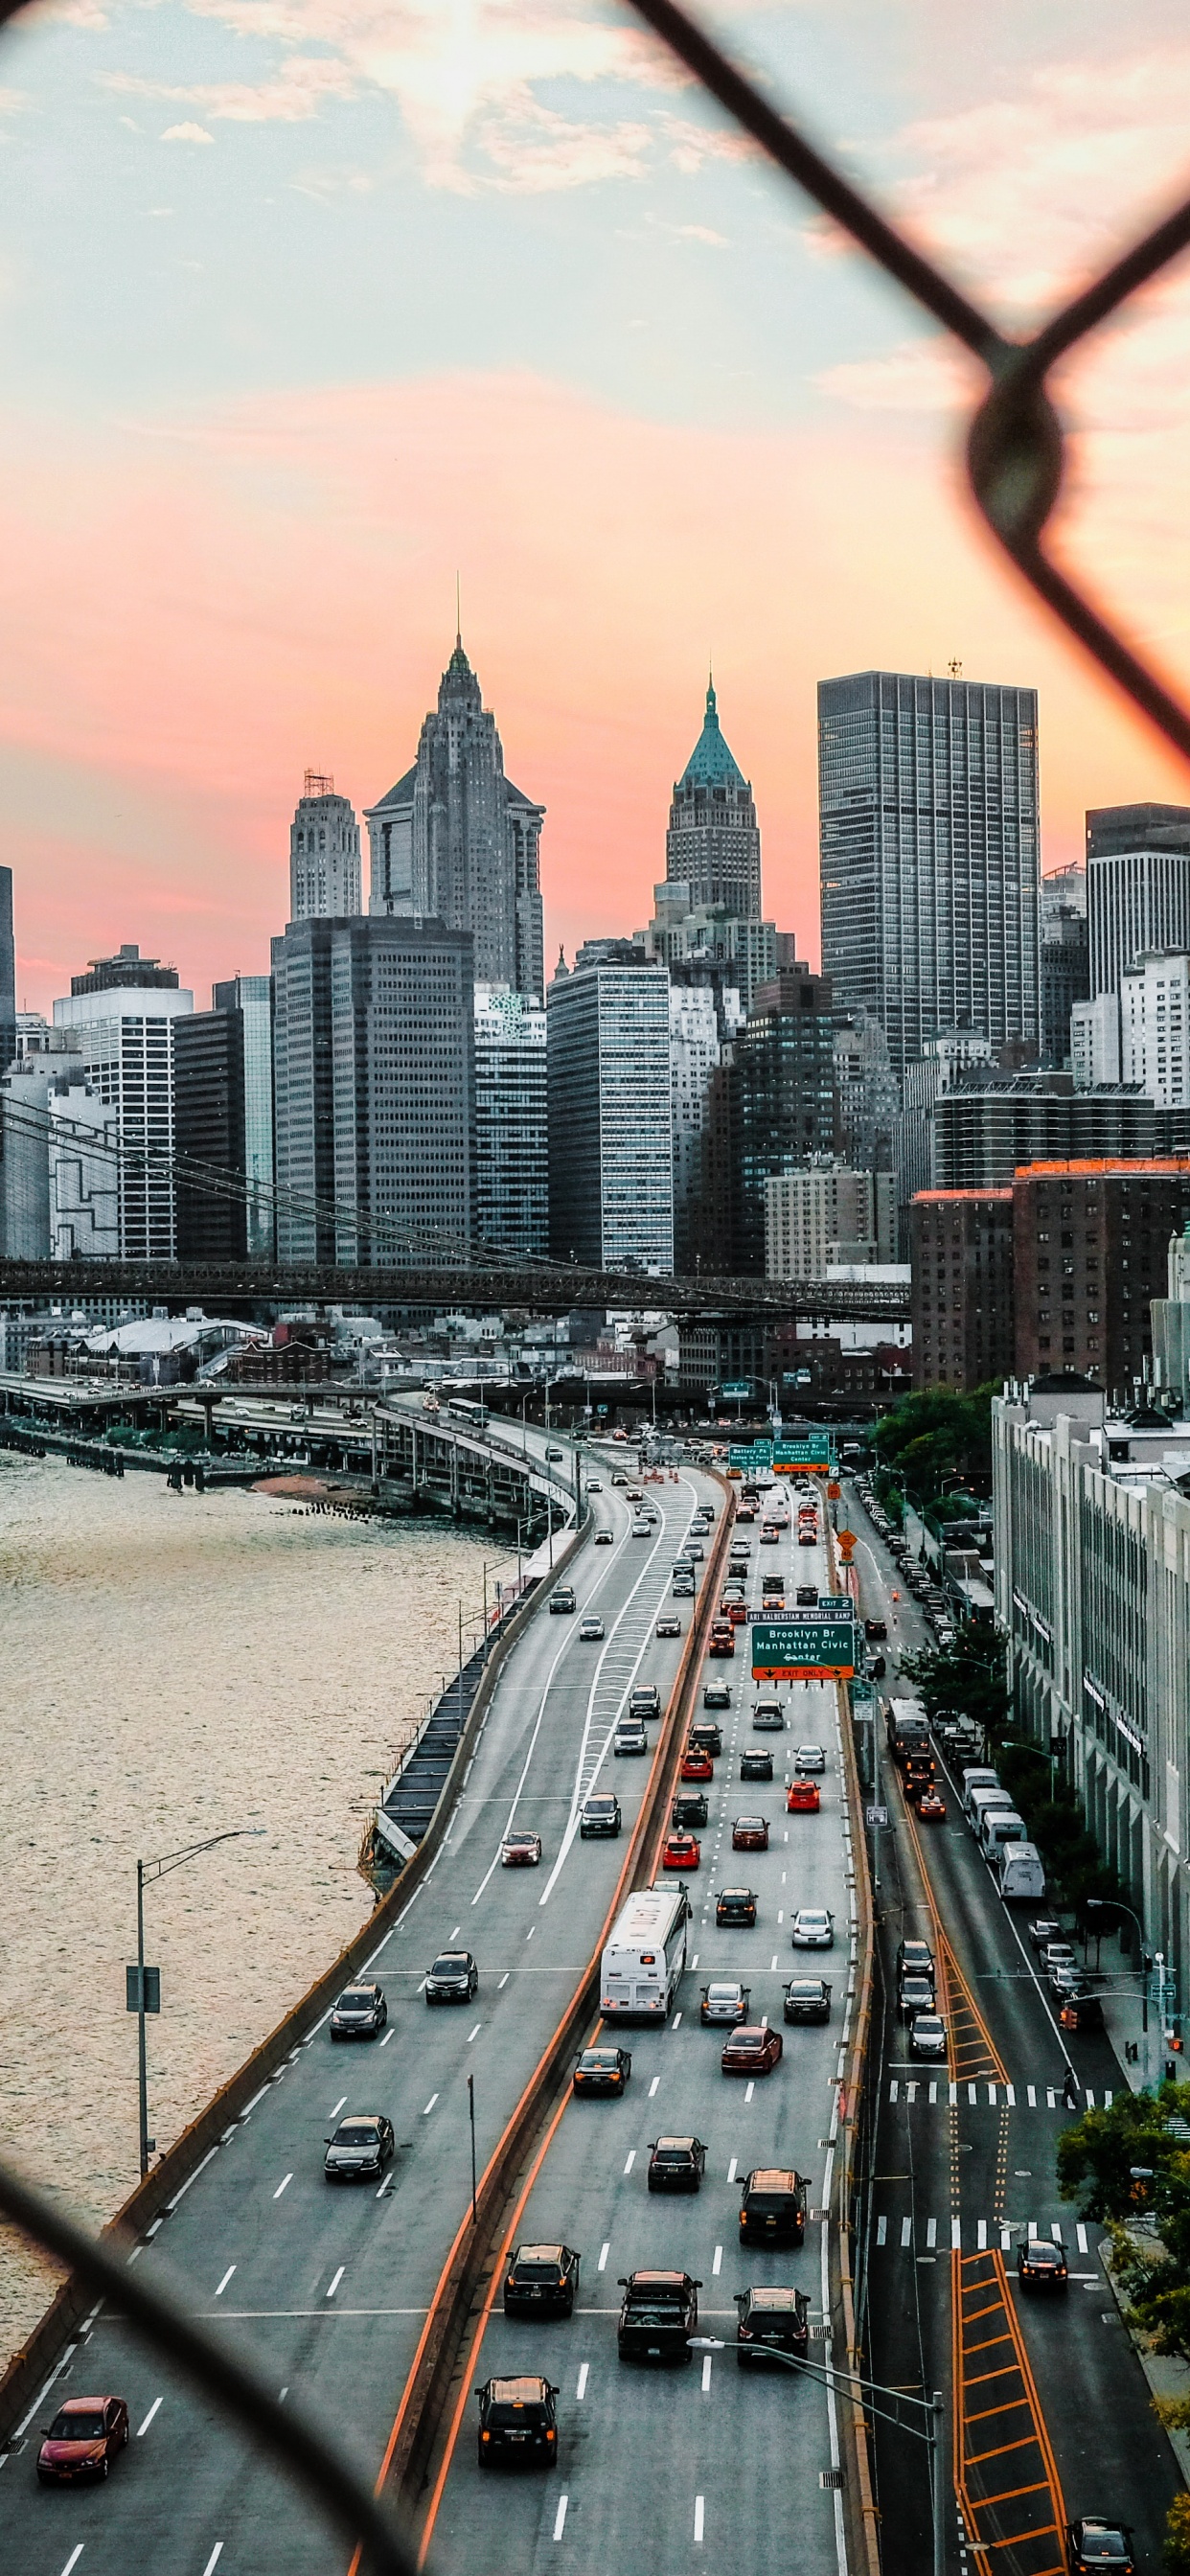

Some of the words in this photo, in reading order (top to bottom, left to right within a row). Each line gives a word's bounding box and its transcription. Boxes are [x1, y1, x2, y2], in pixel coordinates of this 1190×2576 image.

[769, 1630, 818, 1639] Brooklyn
[823, 1629, 835, 1638] Br
[756, 1642, 816, 1650] Manhattan
[821, 1641, 849, 1649] Civic
